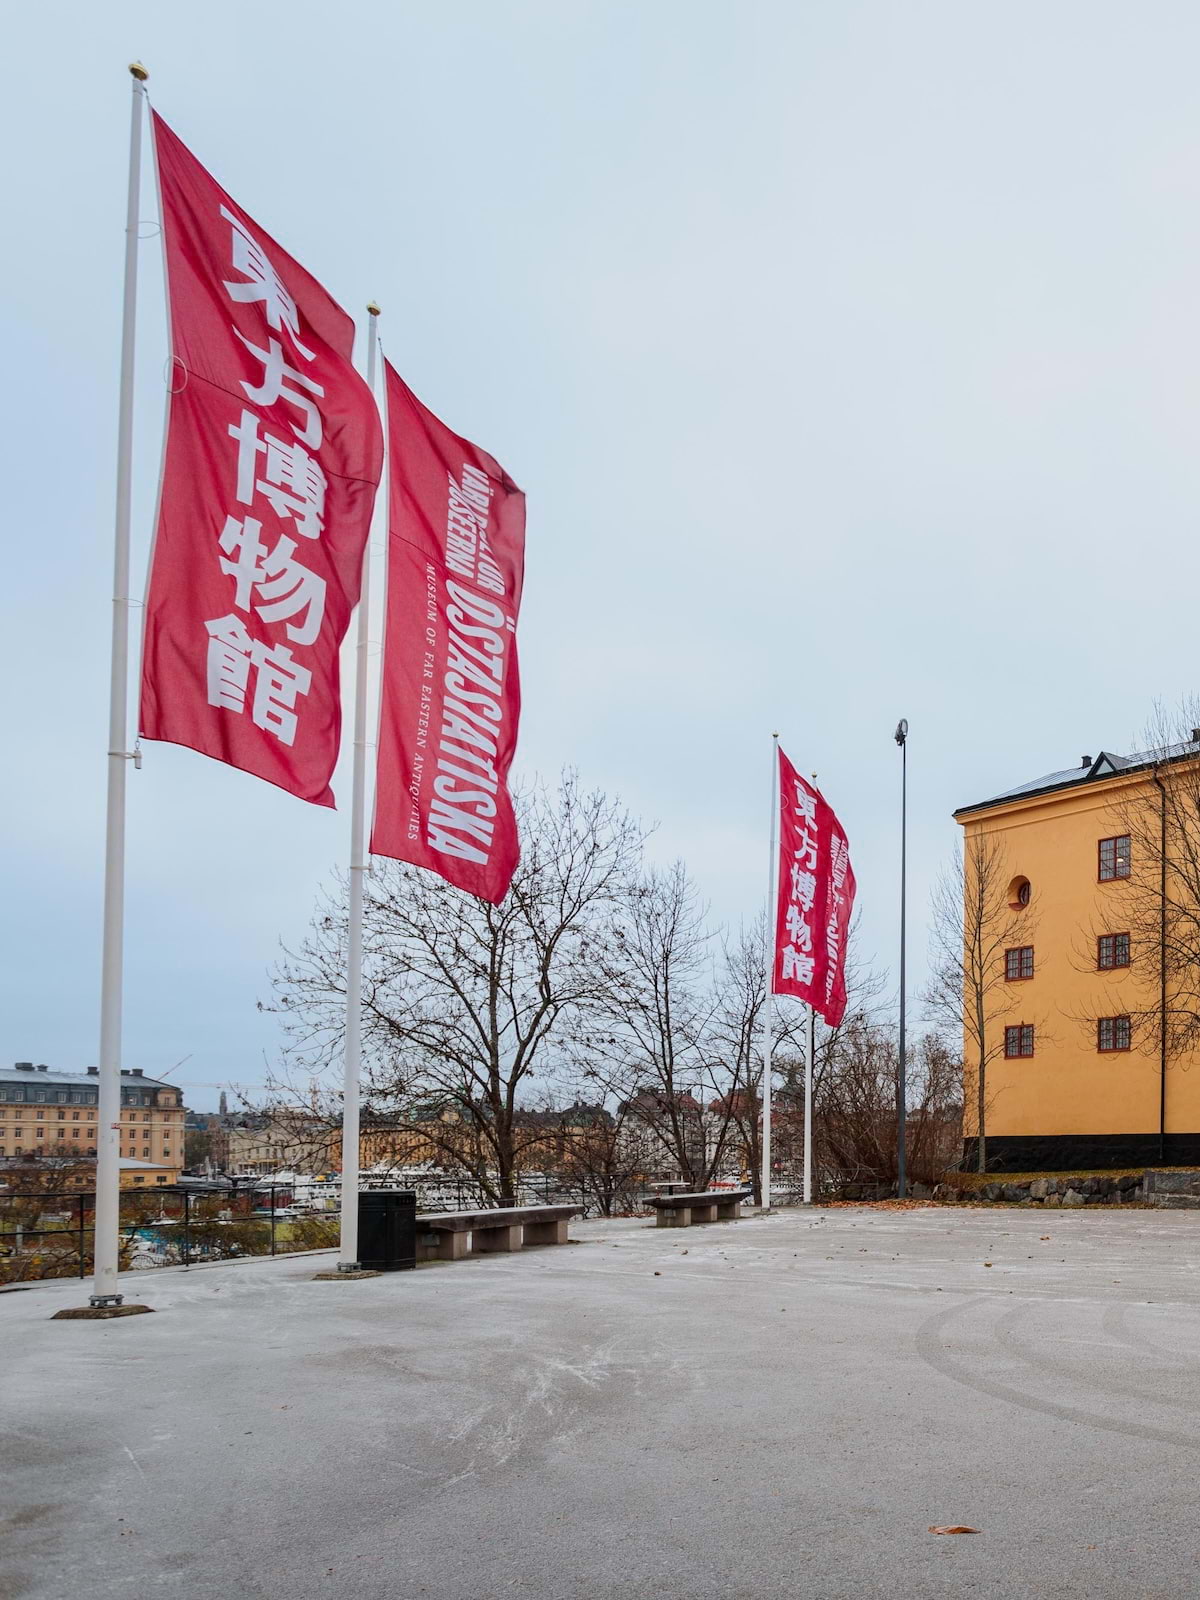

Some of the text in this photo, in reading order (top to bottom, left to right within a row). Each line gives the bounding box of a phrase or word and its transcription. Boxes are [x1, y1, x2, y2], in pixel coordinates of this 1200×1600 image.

[204, 203, 327, 747] 東方博物館
[407, 562, 438, 840] MUSEUM OF FAR EASTERN ANTIQUITIES
[427, 579, 516, 866] ÖSTASIATISKA
[782, 779, 818, 986] 東方博物館
